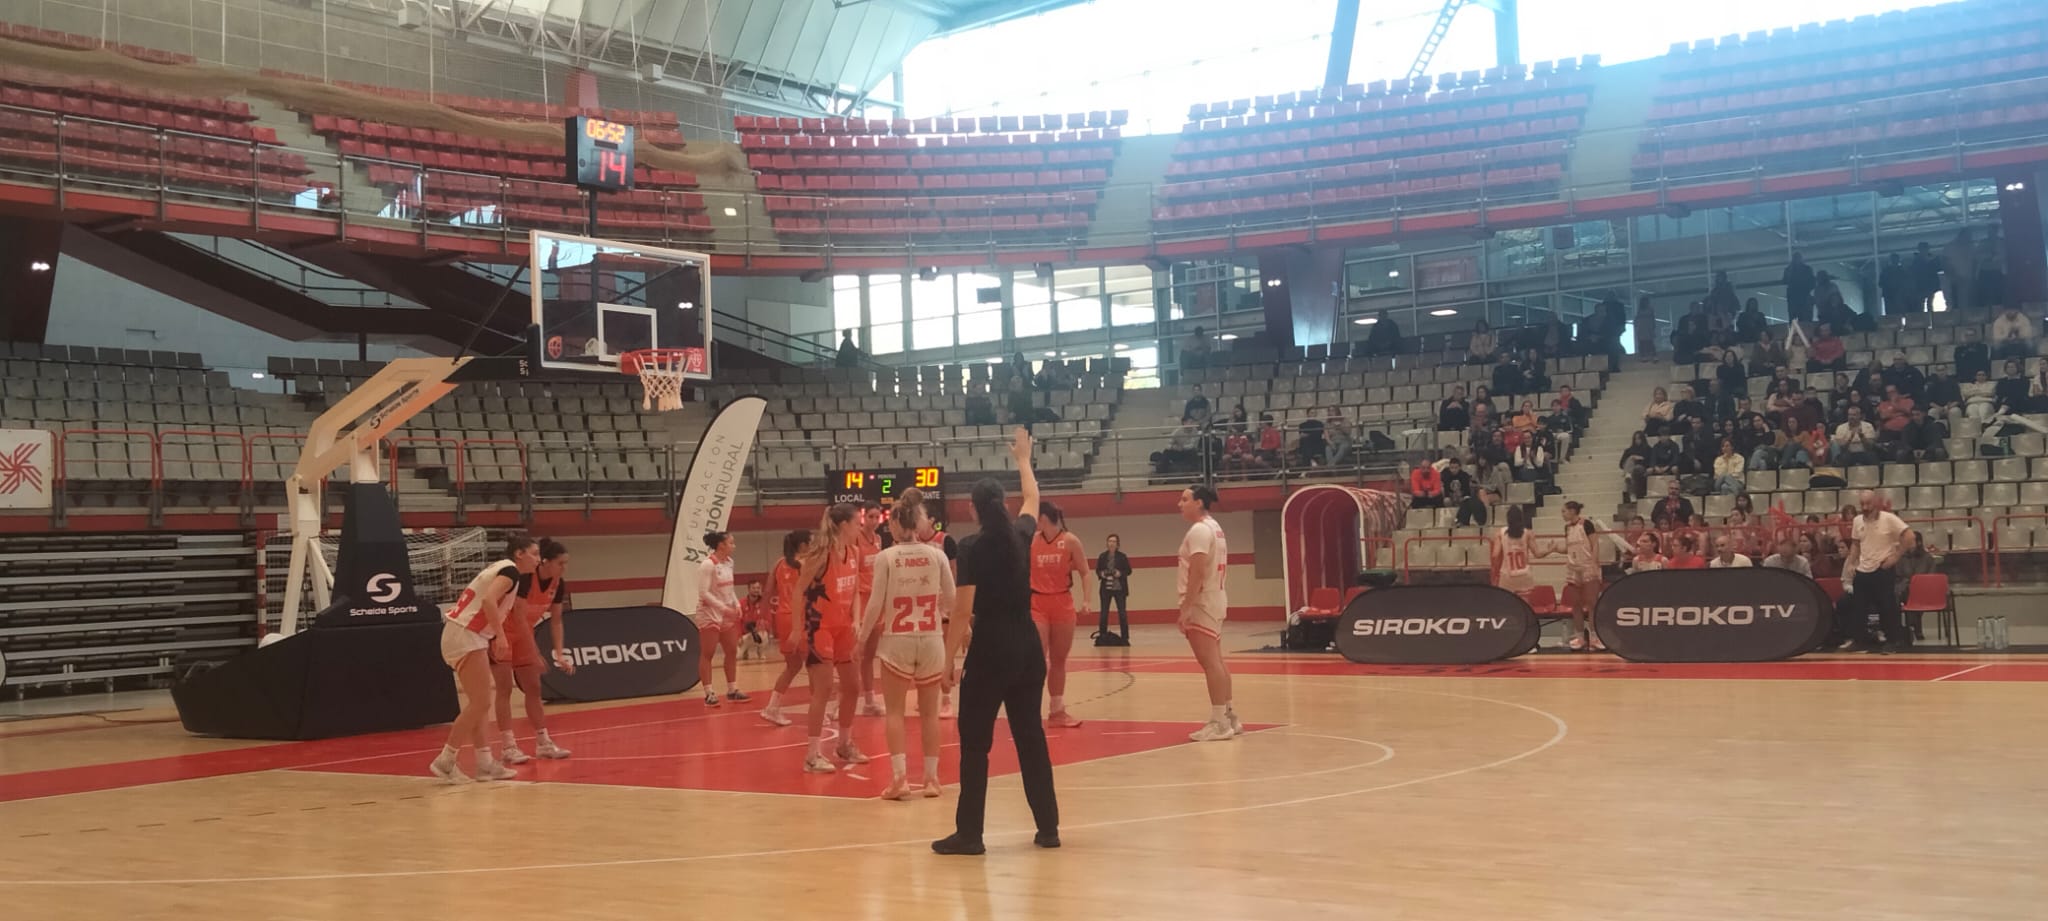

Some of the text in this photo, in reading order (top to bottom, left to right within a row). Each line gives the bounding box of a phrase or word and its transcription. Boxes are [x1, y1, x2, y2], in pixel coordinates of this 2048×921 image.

[599, 150, 627, 186] 14
[846, 471, 864, 489] 14
[882, 479, 892, 494] 2
[915, 468, 939, 487] 30
[834, 494, 865, 503] LOCAL
[1507, 551, 1526, 571] 10
[892, 594, 937, 633] 23
[1616, 604, 1795, 626] SIROKO TV
[1352, 617, 1507, 636] SIROKO TV
[662, 639, 687, 653] TV
